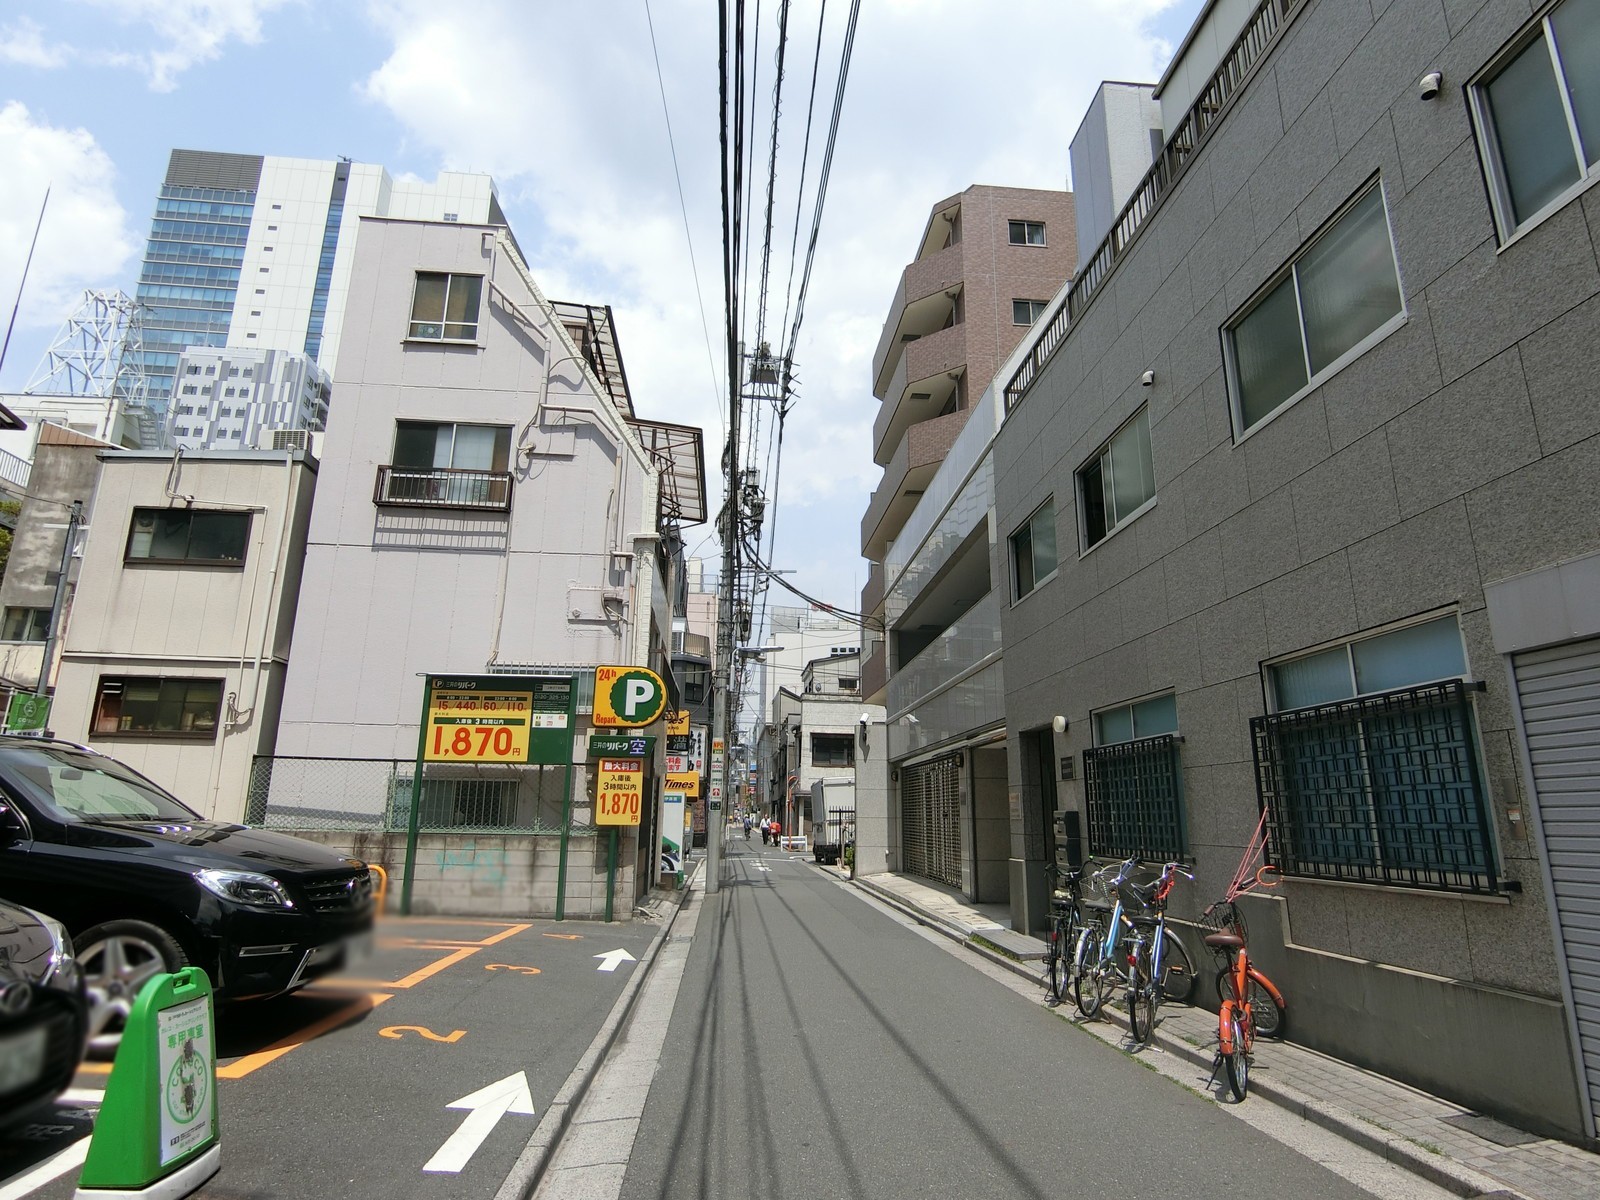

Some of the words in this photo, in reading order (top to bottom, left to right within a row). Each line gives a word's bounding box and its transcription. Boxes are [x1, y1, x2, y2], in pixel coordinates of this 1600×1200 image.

[598, 669, 617, 681] 24h
[446, 681, 477, 689] 三井のリパーク
[625, 679, 655, 716] P
[595, 713, 617, 724] Repark
[592, 741, 629, 752] 三井のリパーク
[629, 738, 646, 755] 空
[603, 761, 639, 771] 最大料金
[610, 774, 632, 782] 入庫後
[602, 782, 637, 791] 3時間以内
[664, 779, 695, 789] Times
[600, 793, 639, 815] 1,870
[631, 815, 639, 823] 円
[542, 932, 584, 941] 4
[484, 963, 543, 976] 3
[377, 1024, 468, 1043] 2
